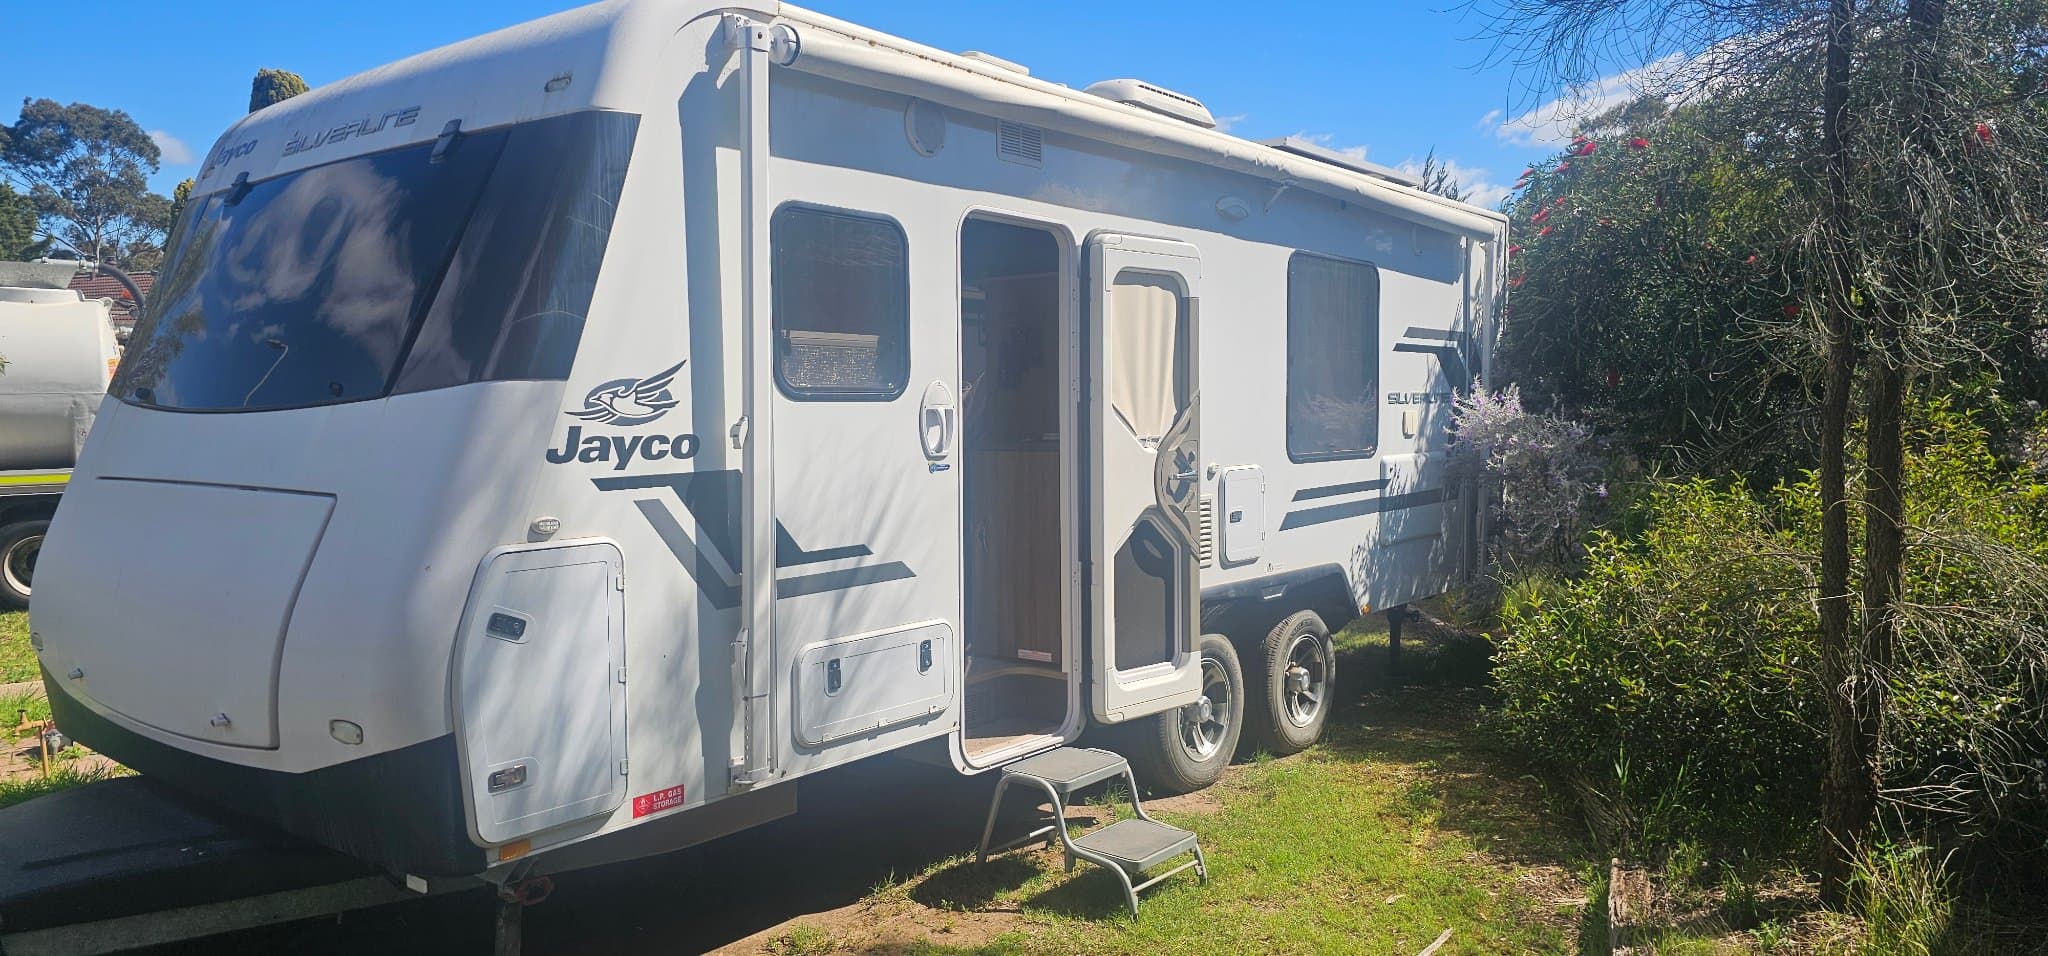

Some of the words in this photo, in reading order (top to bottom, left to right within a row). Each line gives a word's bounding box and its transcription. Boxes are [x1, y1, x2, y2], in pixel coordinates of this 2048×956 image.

[281, 106, 421, 157] SILVERLINE
[546, 426, 700, 471] Jayco
[653, 793, 666, 801] L.P.
[668, 788, 682, 797] GAS
[653, 795, 682, 810] STORAGE
